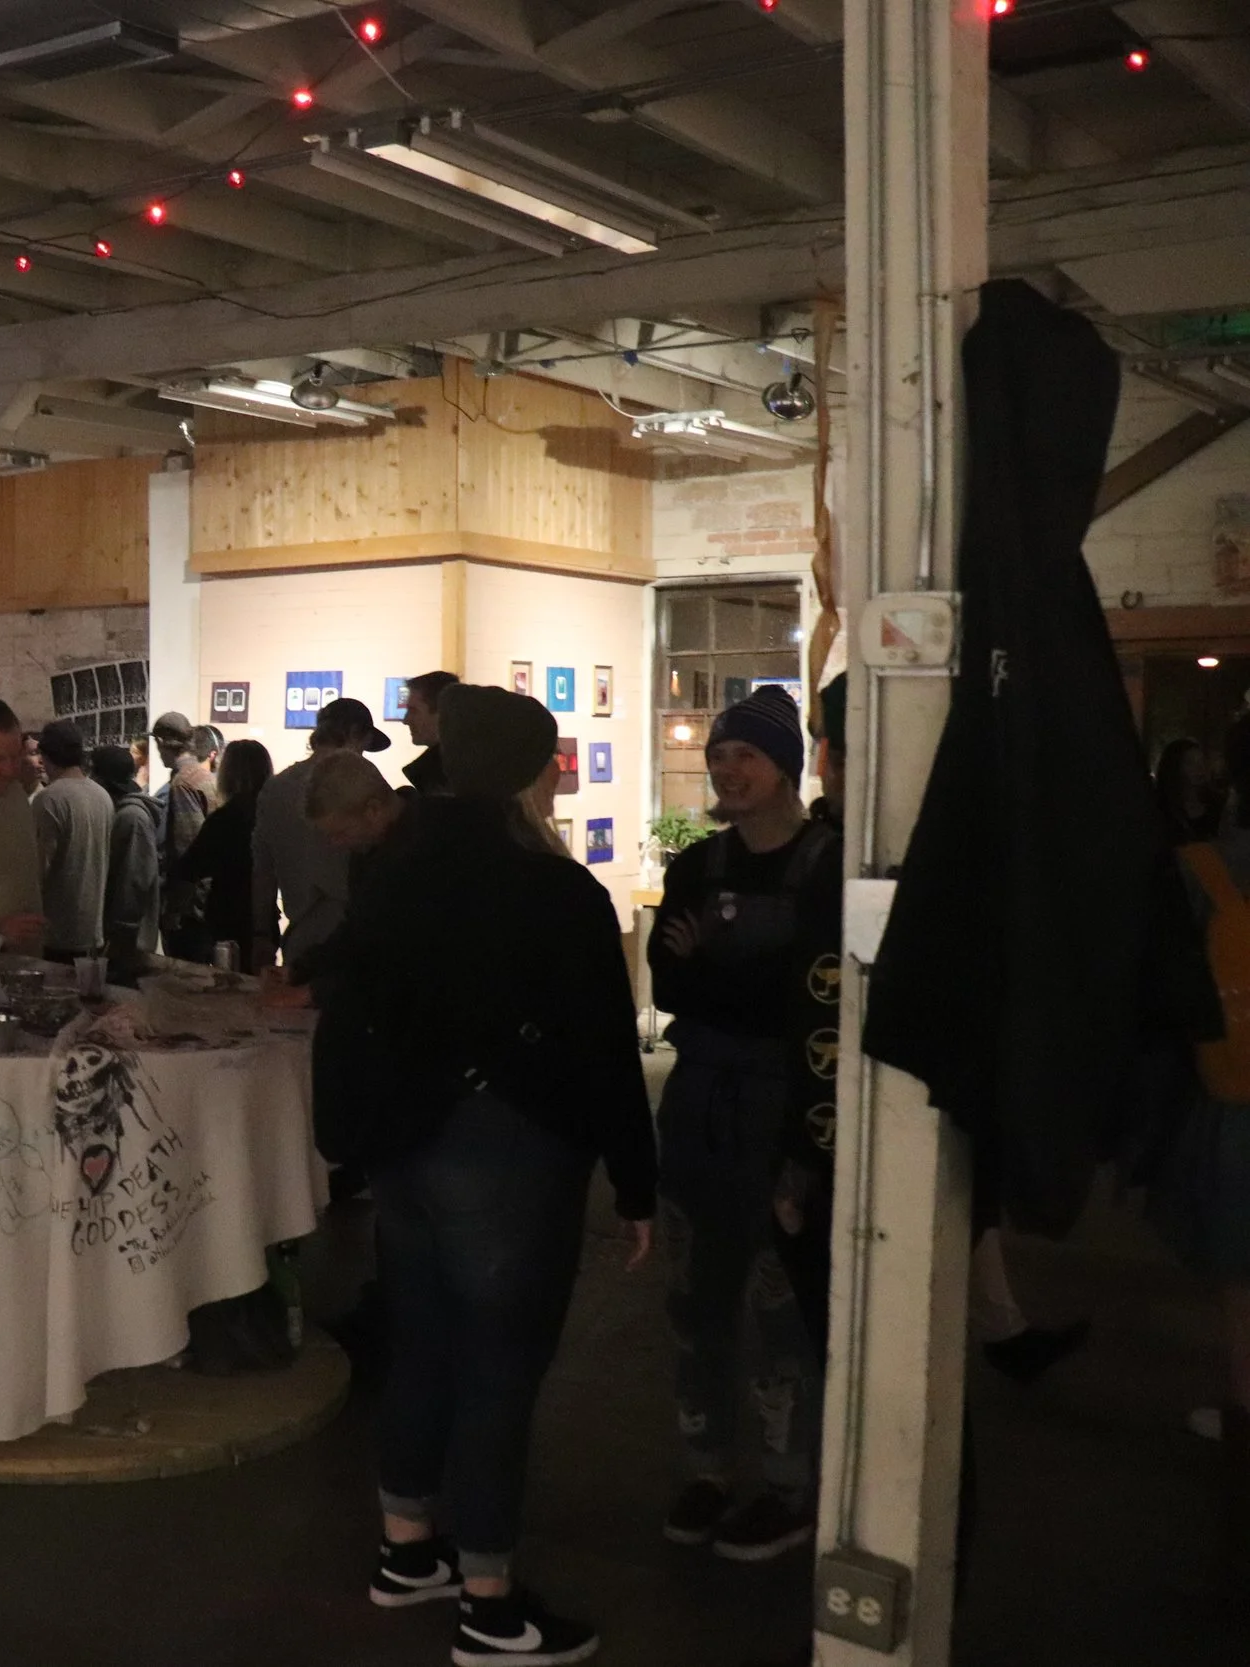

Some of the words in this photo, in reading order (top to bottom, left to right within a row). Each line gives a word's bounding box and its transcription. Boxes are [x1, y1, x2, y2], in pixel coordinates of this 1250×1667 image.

[78, 1192, 114, 1218] HIP
[118, 1126, 183, 1198] DEATH
[71, 1180, 180, 1256] GODDESS
